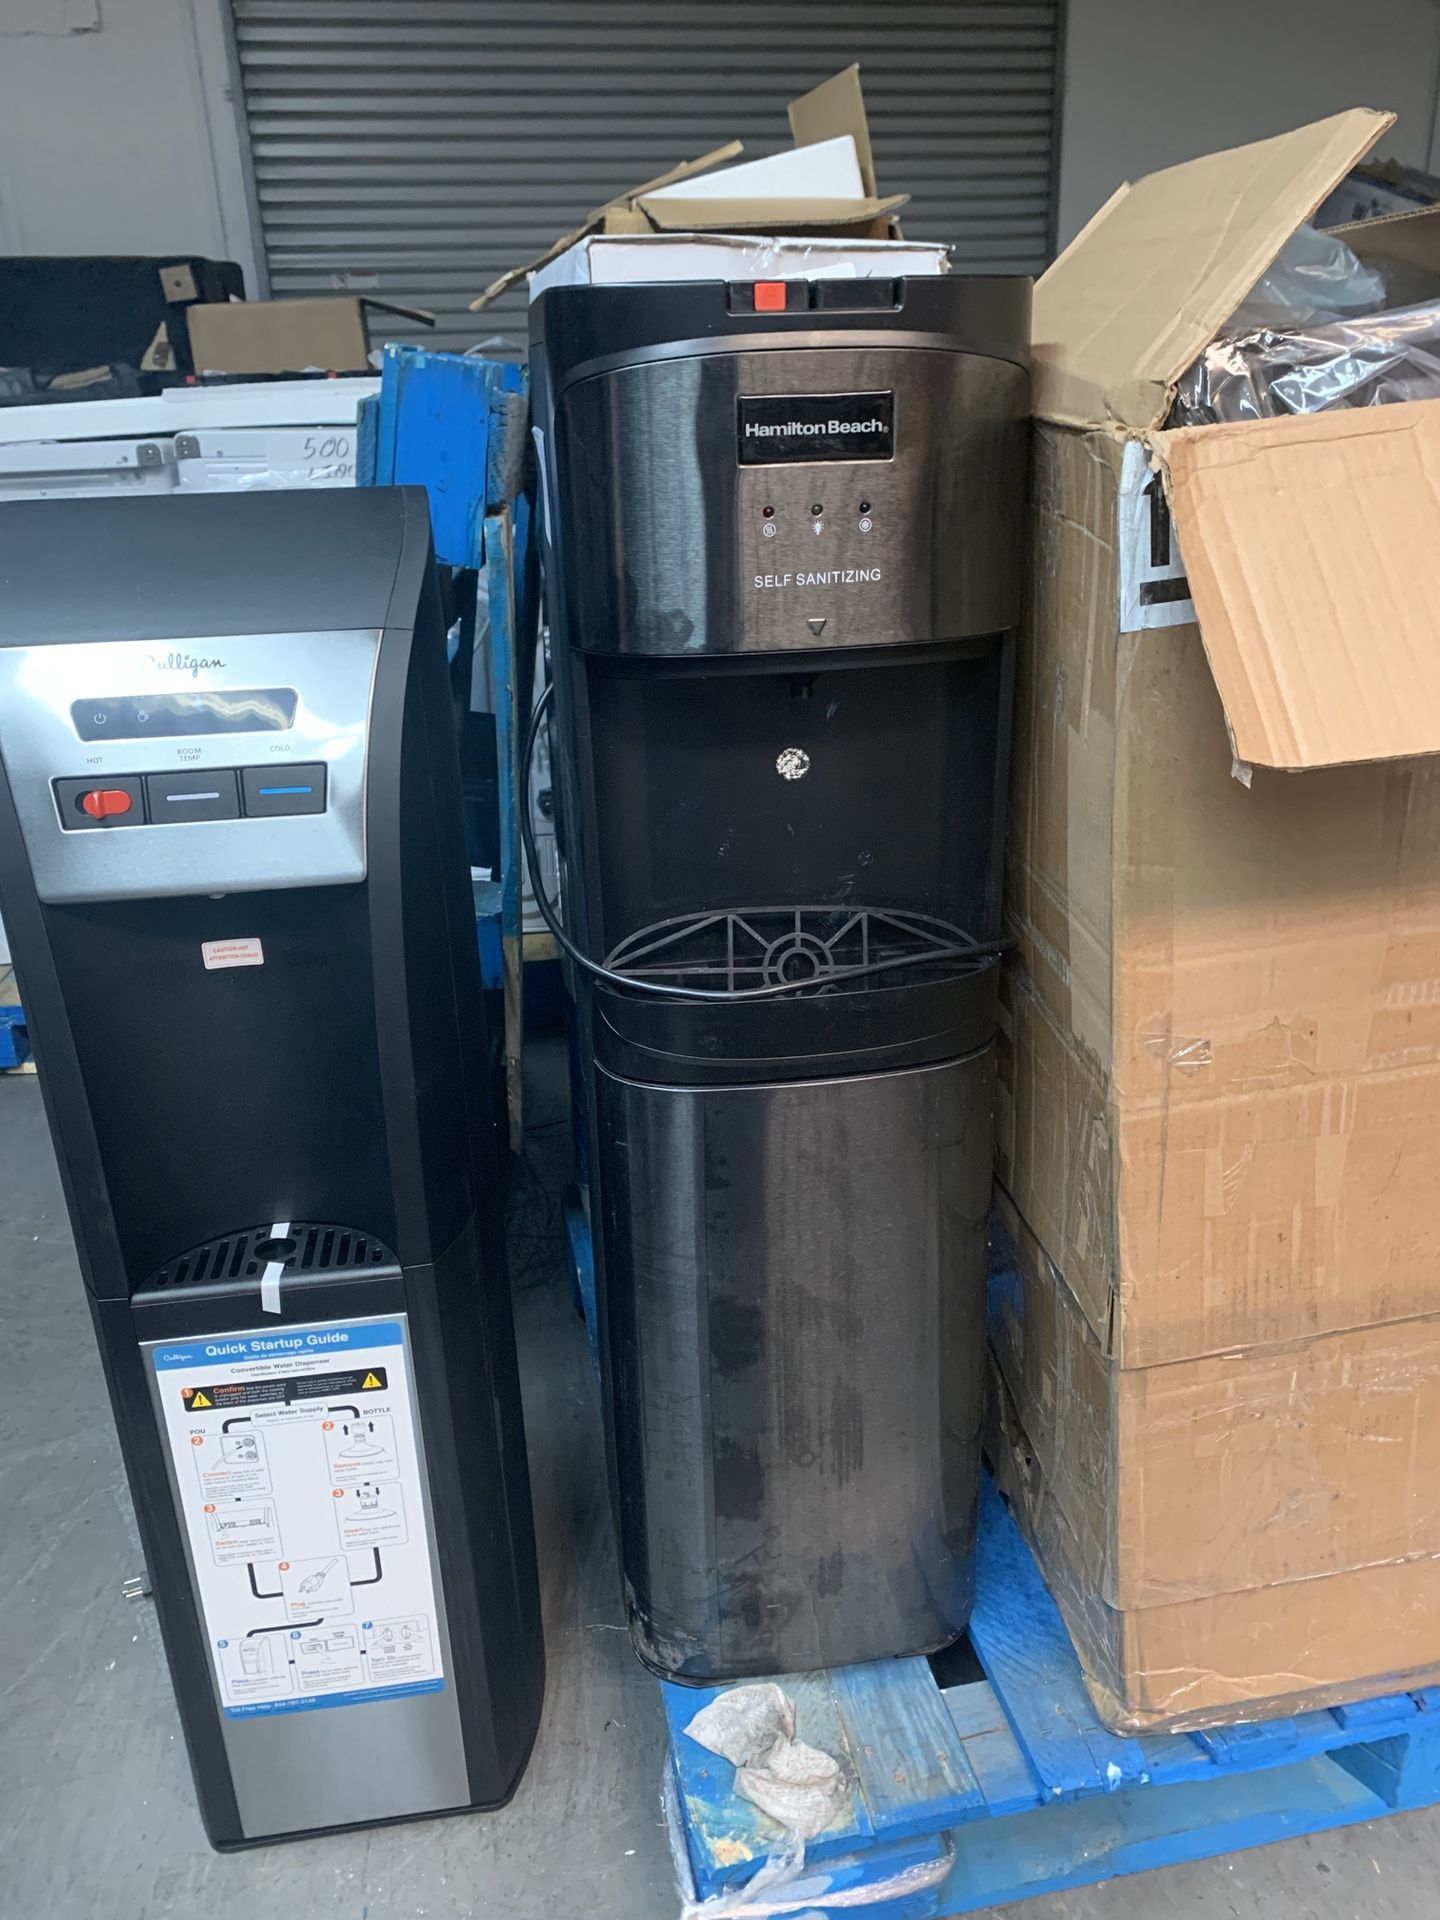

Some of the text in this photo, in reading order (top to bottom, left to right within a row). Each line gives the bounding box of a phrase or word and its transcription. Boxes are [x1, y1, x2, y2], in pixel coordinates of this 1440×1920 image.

[745, 419, 883, 437] Hamilton Beach
[303, 436, 349, 460] 500
[754, 568, 881, 588] SELF SANITIZING
[177, 747, 202, 756] ROOM
[269, 745, 291, 753] COLD
[86, 756, 103, 764] HOT
[179, 754, 200, 762] TEMP
[205, 1331, 349, 1357] Quick Startup Guide
[230, 1358, 330, 1374] Convertible Water Dispenser
[213, 1385, 245, 1394] Confirm
[254, 1411, 276, 1419] Select
[278, 1408, 297, 1416] Water
[299, 1406, 324, 1414] Supply
[362, 1407, 391, 1415] BOTTLE
[189, 1428, 206, 1436] POU
